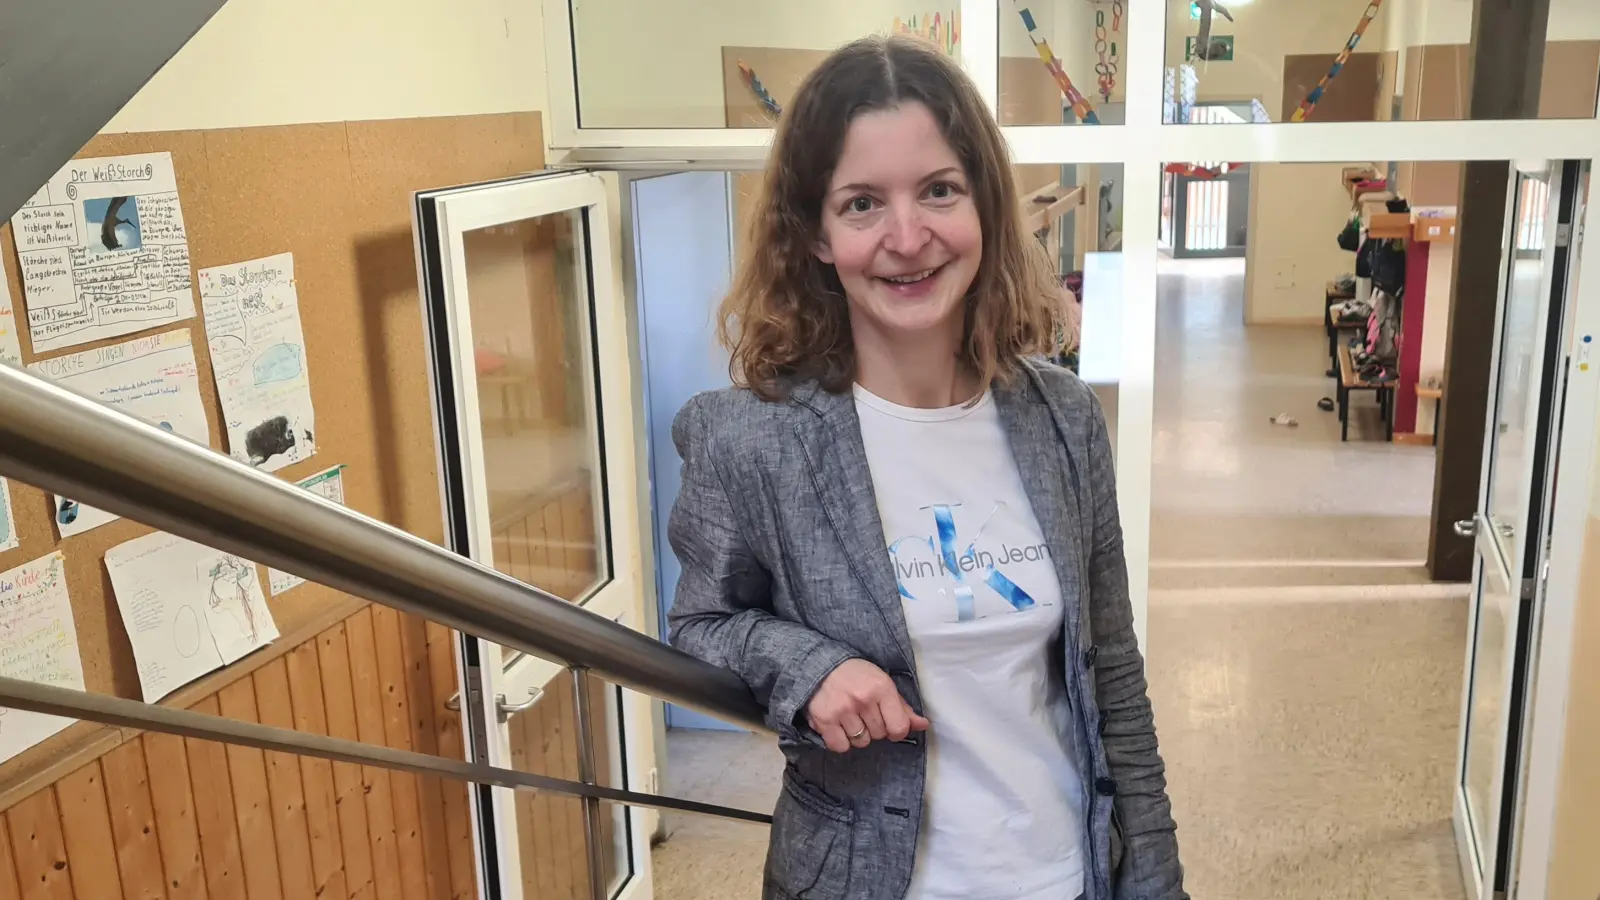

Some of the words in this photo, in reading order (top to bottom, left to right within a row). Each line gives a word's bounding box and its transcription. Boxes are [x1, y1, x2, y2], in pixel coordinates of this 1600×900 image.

[71, 169, 87, 182] Der
[55, 220, 74, 230] Name
[96, 345, 125, 365] SINGEN
[894, 556, 934, 579] lvin
[938, 546, 994, 577] Klein
[998, 543, 1052, 566] Jean
